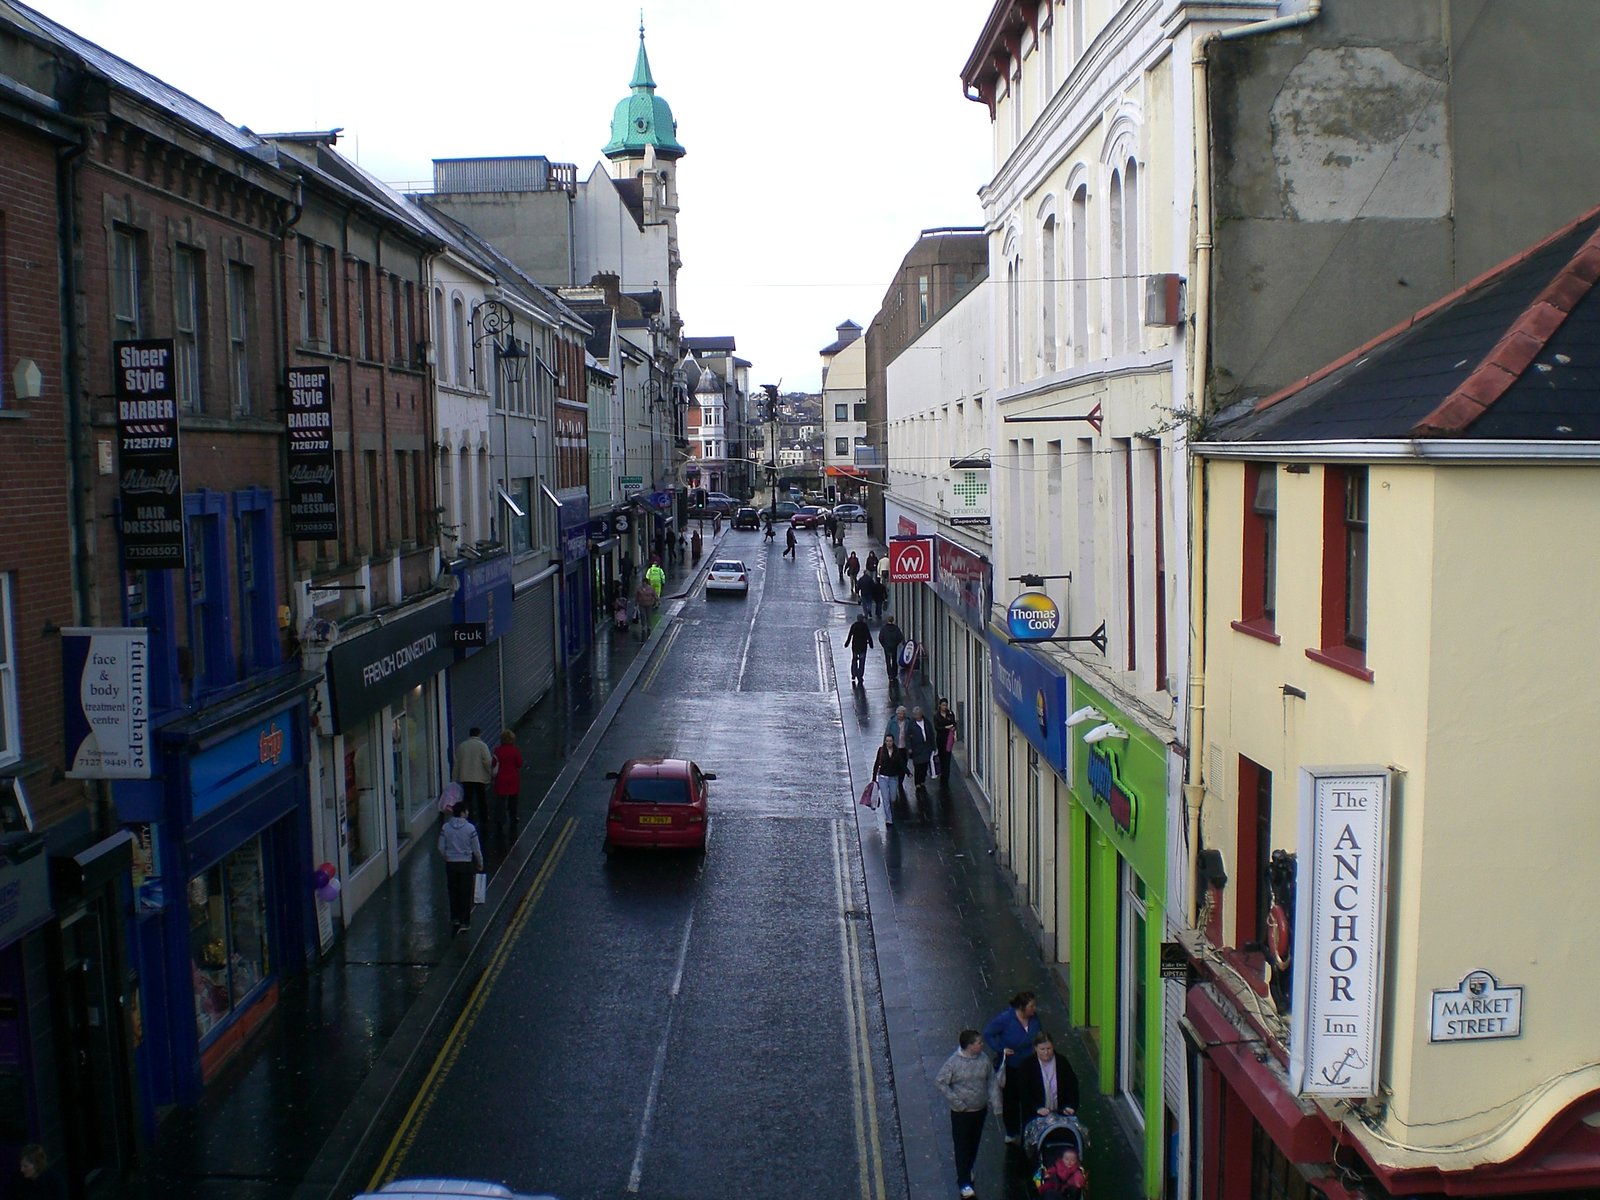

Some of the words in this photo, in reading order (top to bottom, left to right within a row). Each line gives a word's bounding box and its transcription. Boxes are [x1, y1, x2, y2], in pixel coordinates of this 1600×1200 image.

[121, 346, 167, 368] Sheer
[125, 369, 165, 394] Style
[289, 372, 325, 388] Sheer
[292, 389, 323, 408] Style
[120, 400, 174, 420] BARBER
[288, 412, 330, 428] BARBER
[301, 492, 324, 503] HAIR
[137, 506, 166, 519] HAIR
[291, 503, 336, 514] DRESSING
[953, 508, 987, 516] pharmacy
[123, 519, 181, 534] DRESSING
[128, 546, 178, 556] 71308502
[1010, 608, 1056, 620] Thomas
[1028, 618, 1056, 630] Cook
[454, 628, 482, 640] fcuk
[93, 653, 117, 665] face
[363, 653, 396, 687] FRENCH
[395, 632, 437, 670] CONNECTION
[100, 671, 109, 681] &
[90, 684, 120, 699] body
[85, 703, 126, 712] treatment
[128, 640, 147, 768] futureshape
[92, 715, 120, 725] centre
[79, 758, 100, 767] 7127
[104, 759, 127, 767] 9449
[1332, 792, 1367, 808] The
[1330, 823, 1362, 1002] ANCHOR
[1442, 998, 1513, 1017] MARKET
[1324, 1017, 1357, 1034] Inn
[1447, 1018, 1508, 1035] STREET
